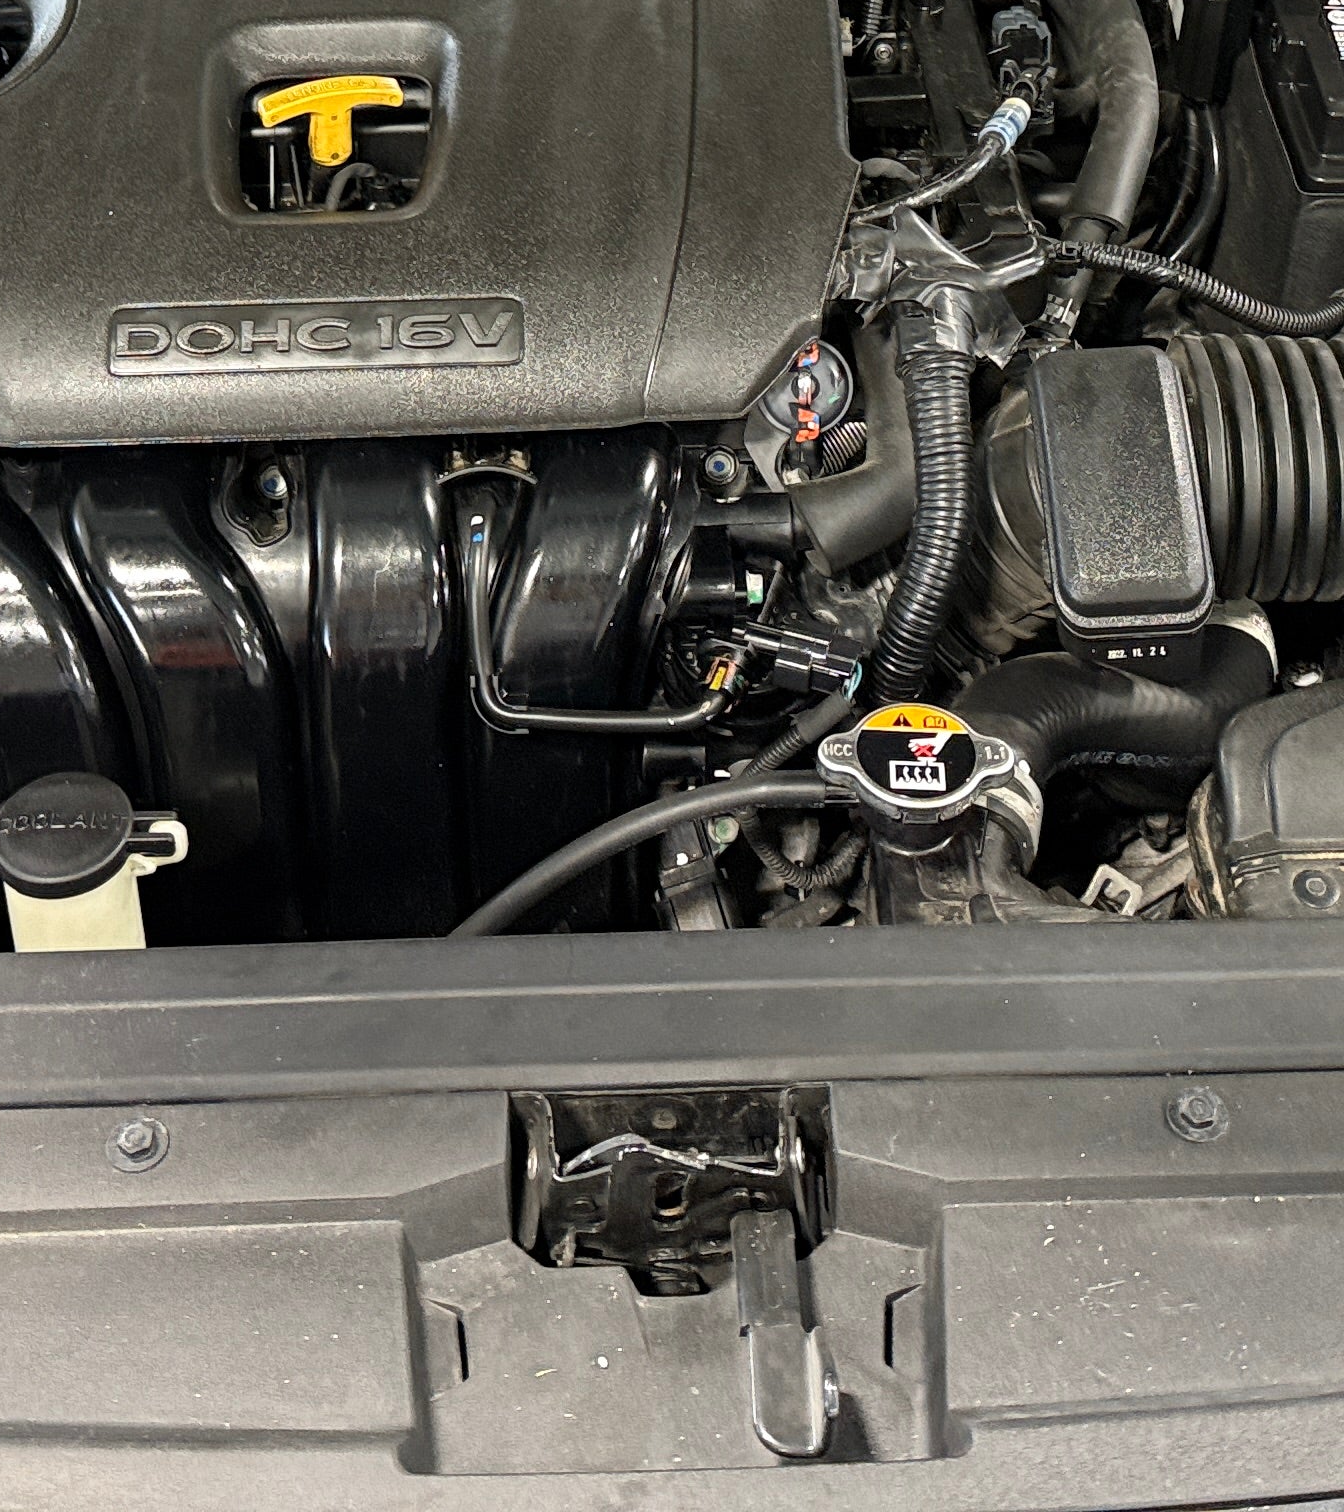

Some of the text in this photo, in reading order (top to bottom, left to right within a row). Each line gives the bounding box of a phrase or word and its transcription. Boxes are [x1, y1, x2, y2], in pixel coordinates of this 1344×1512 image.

[114, 311, 514, 357] DOHC 16V
[822, 743, 853, 757] HCC
[984, 745, 1007, 761] 1.1
